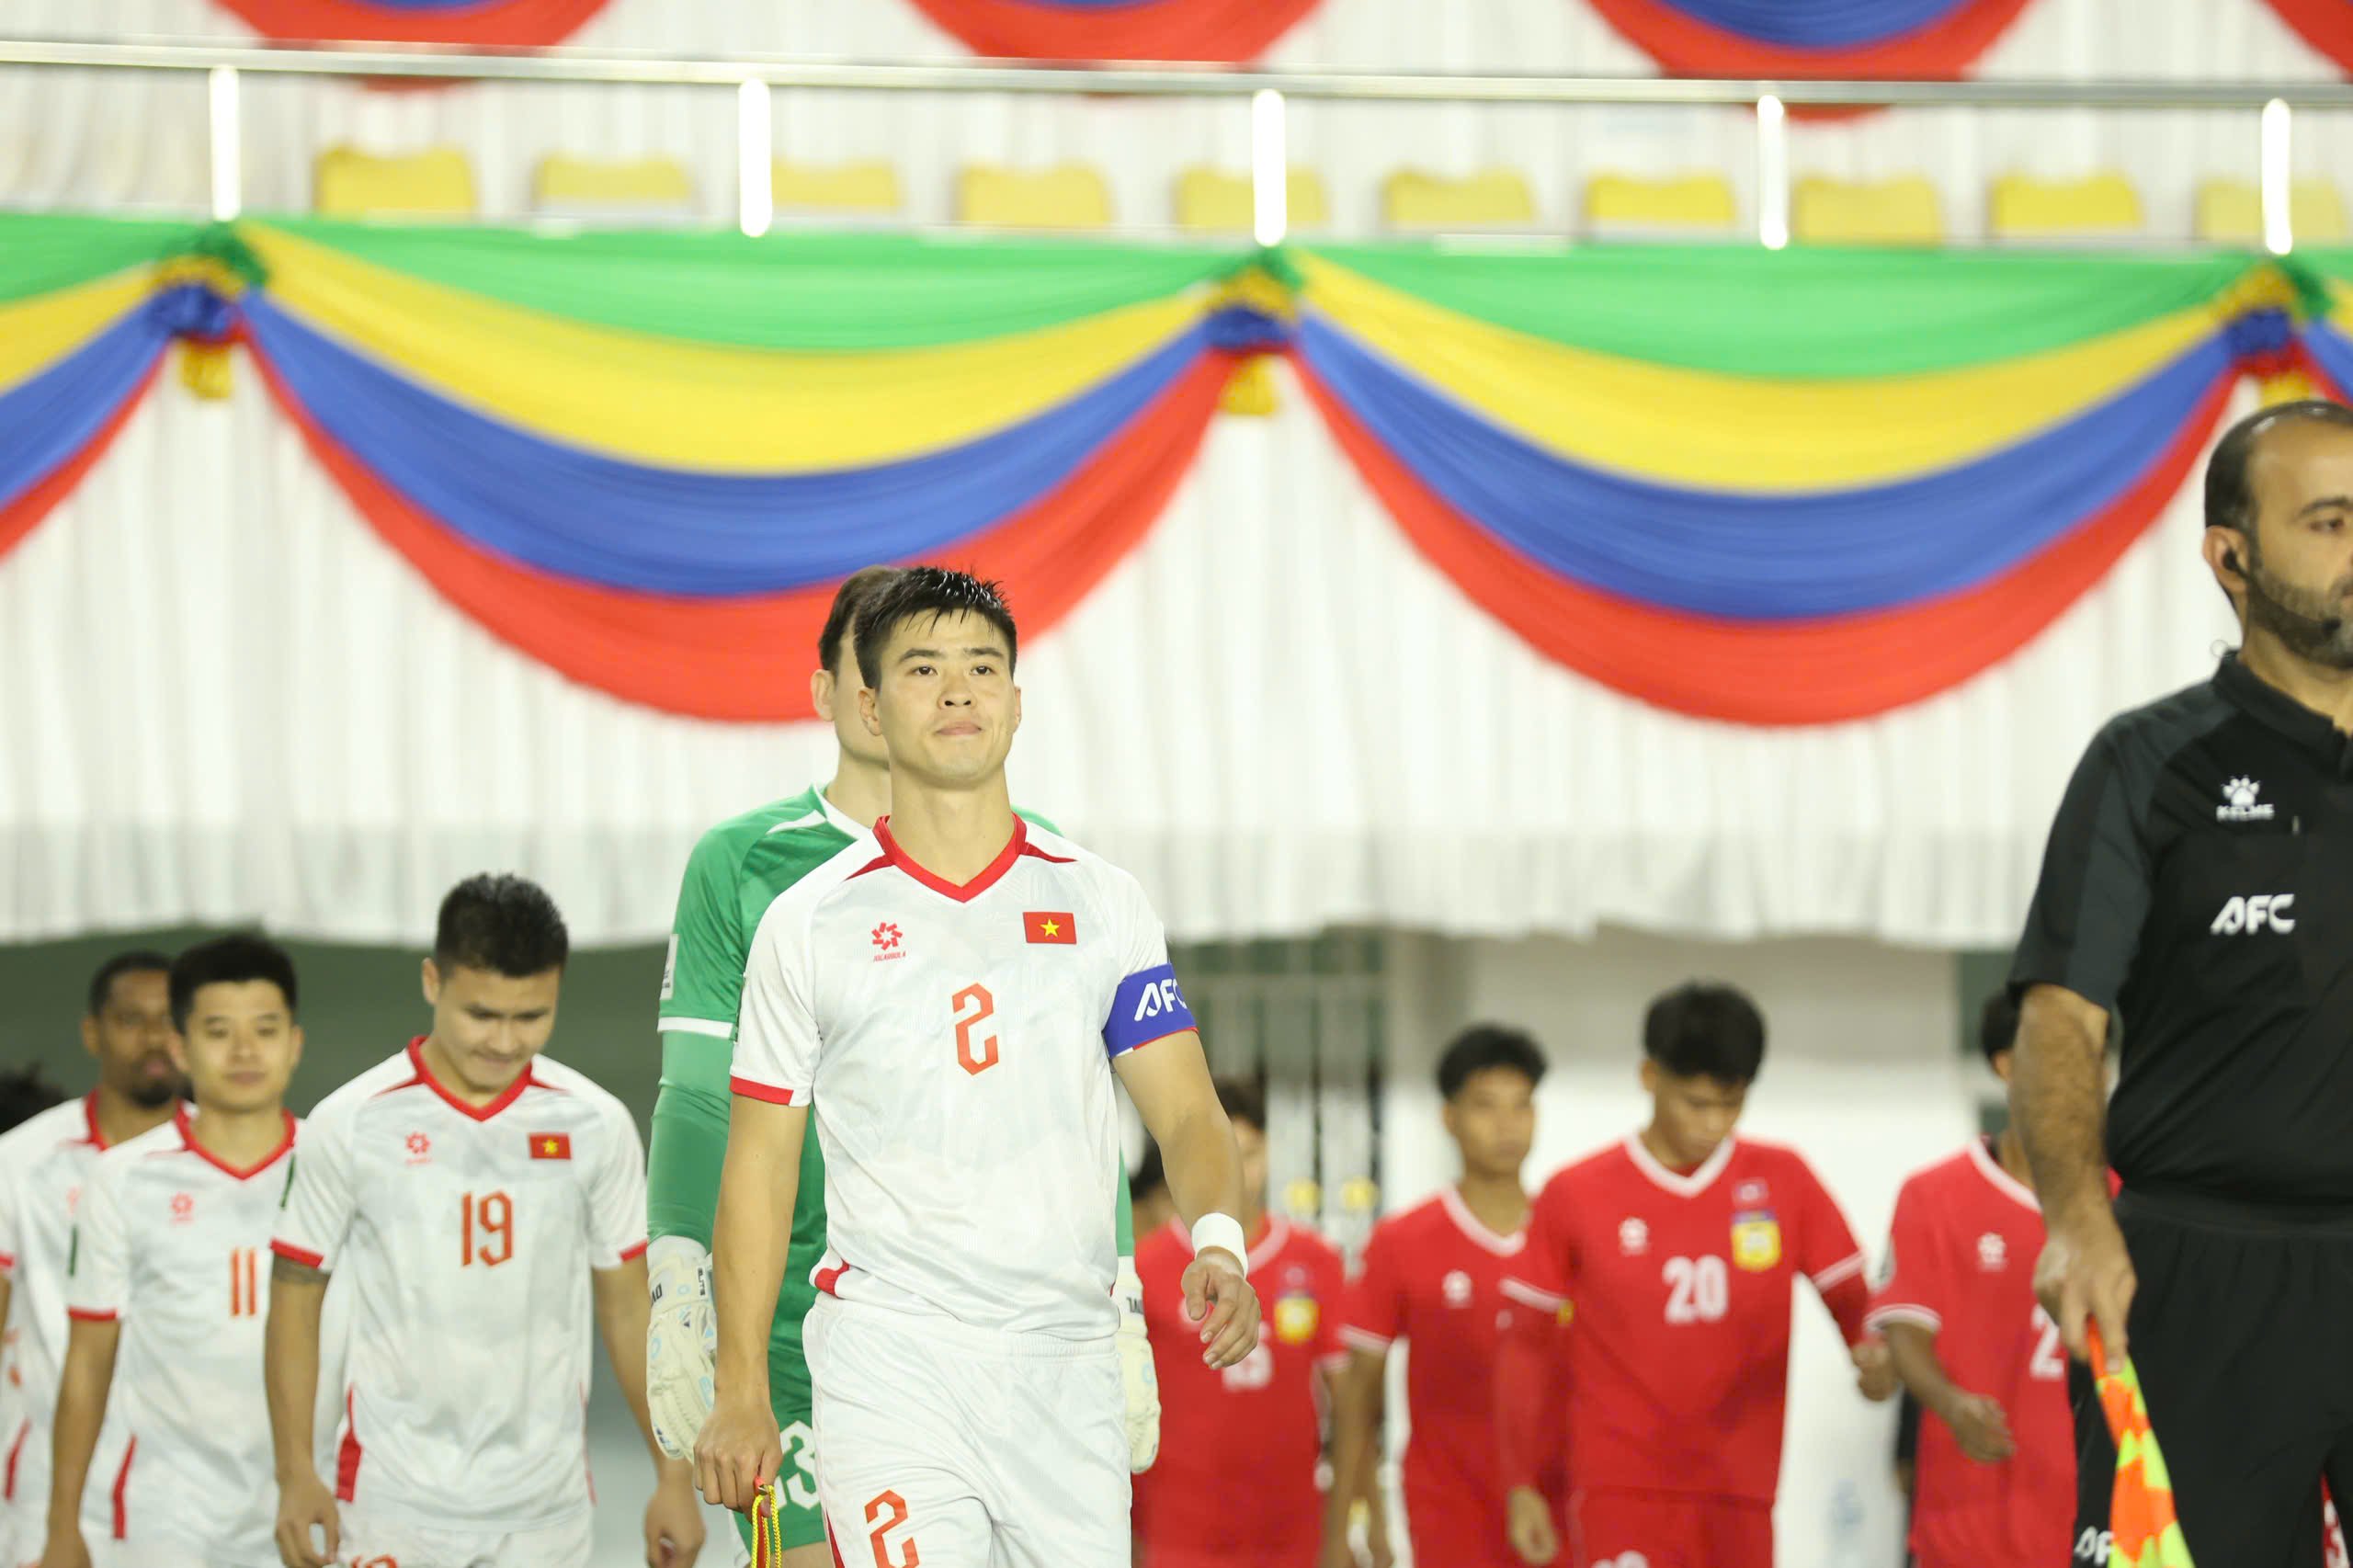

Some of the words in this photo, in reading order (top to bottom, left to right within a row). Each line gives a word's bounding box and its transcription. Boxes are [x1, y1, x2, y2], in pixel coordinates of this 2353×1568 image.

[2210, 893, 2296, 936] AFC
[952, 983, 999, 1075] 2
[462, 1190, 513, 1267] 19
[231, 1248, 256, 1316] 11
[1661, 1255, 1730, 1325] 20
[774, 1419, 821, 1511] 3
[864, 1489, 920, 1568] 2
[2074, 1526, 2115, 1566] AF
